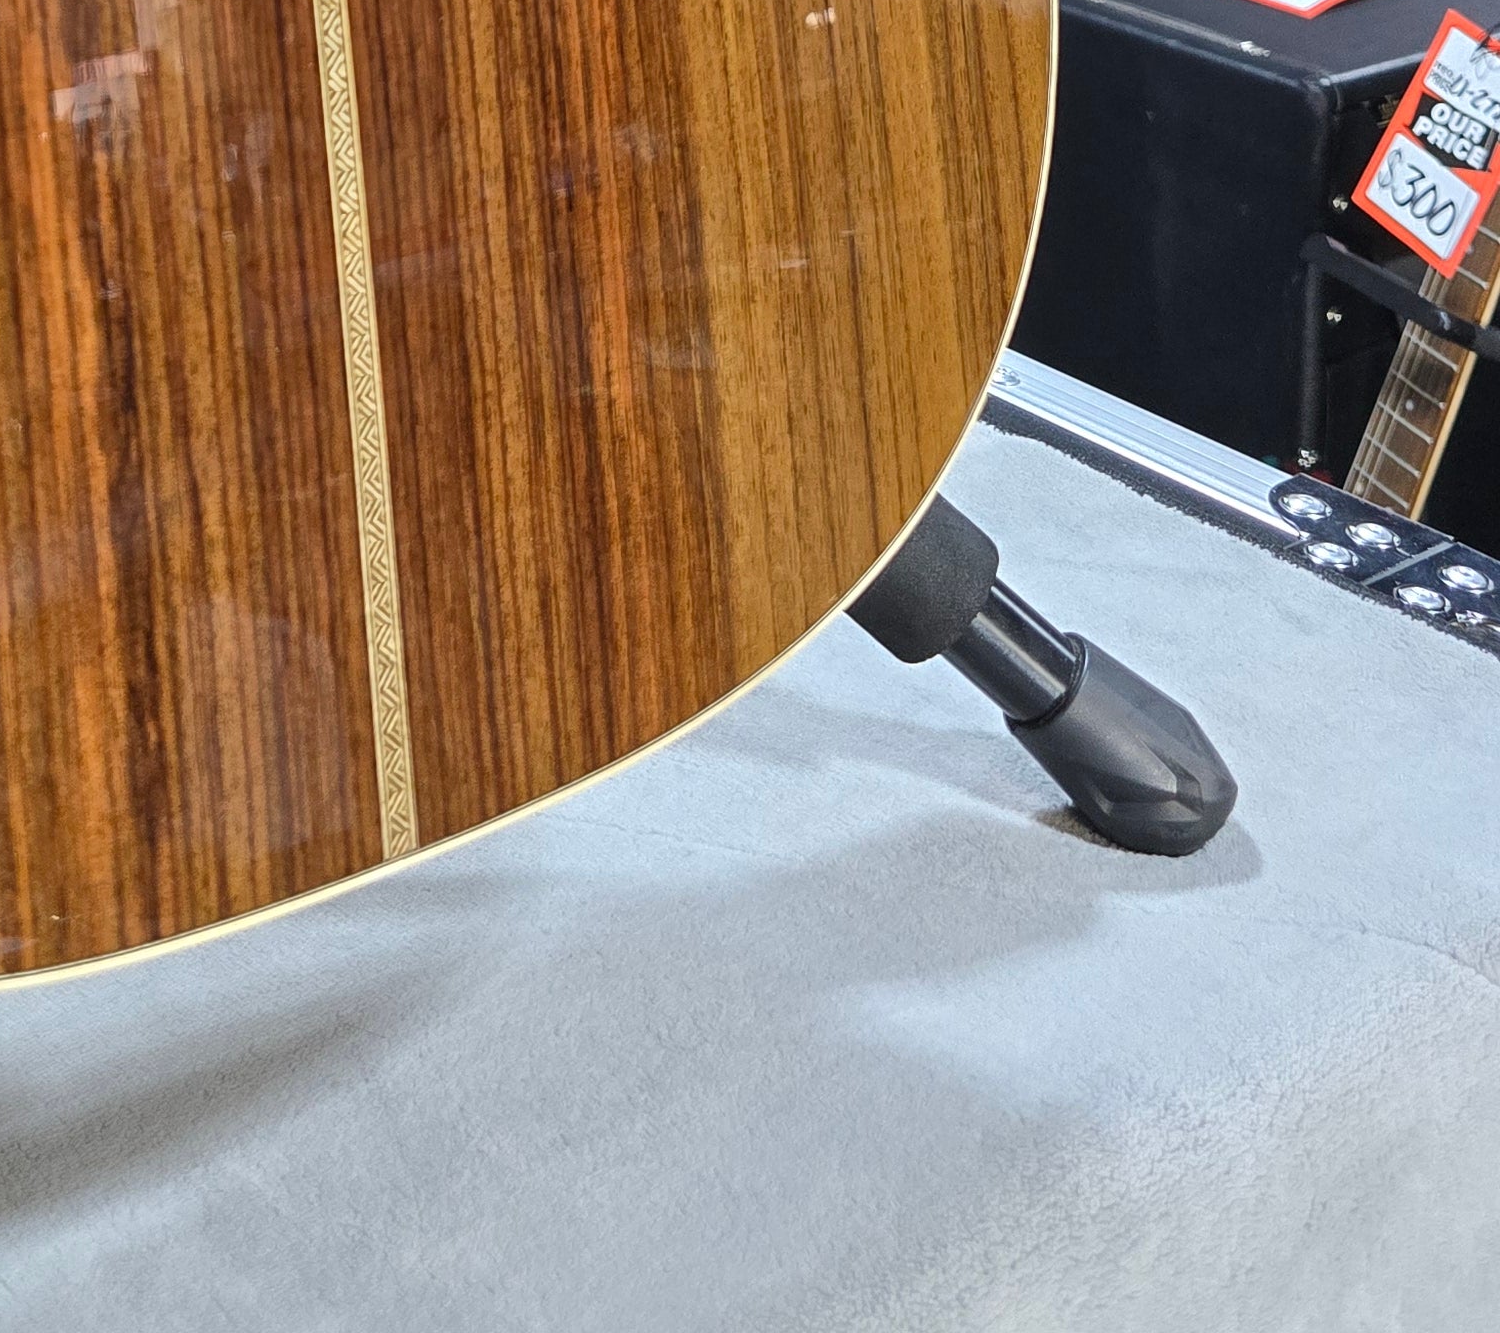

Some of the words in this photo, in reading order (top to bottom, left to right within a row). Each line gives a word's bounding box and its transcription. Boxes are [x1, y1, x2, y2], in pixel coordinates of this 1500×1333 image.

[1412, 115, 1489, 170] PRICE
[1430, 101, 1486, 145] OUR
[1378, 147, 1457, 237] $300
